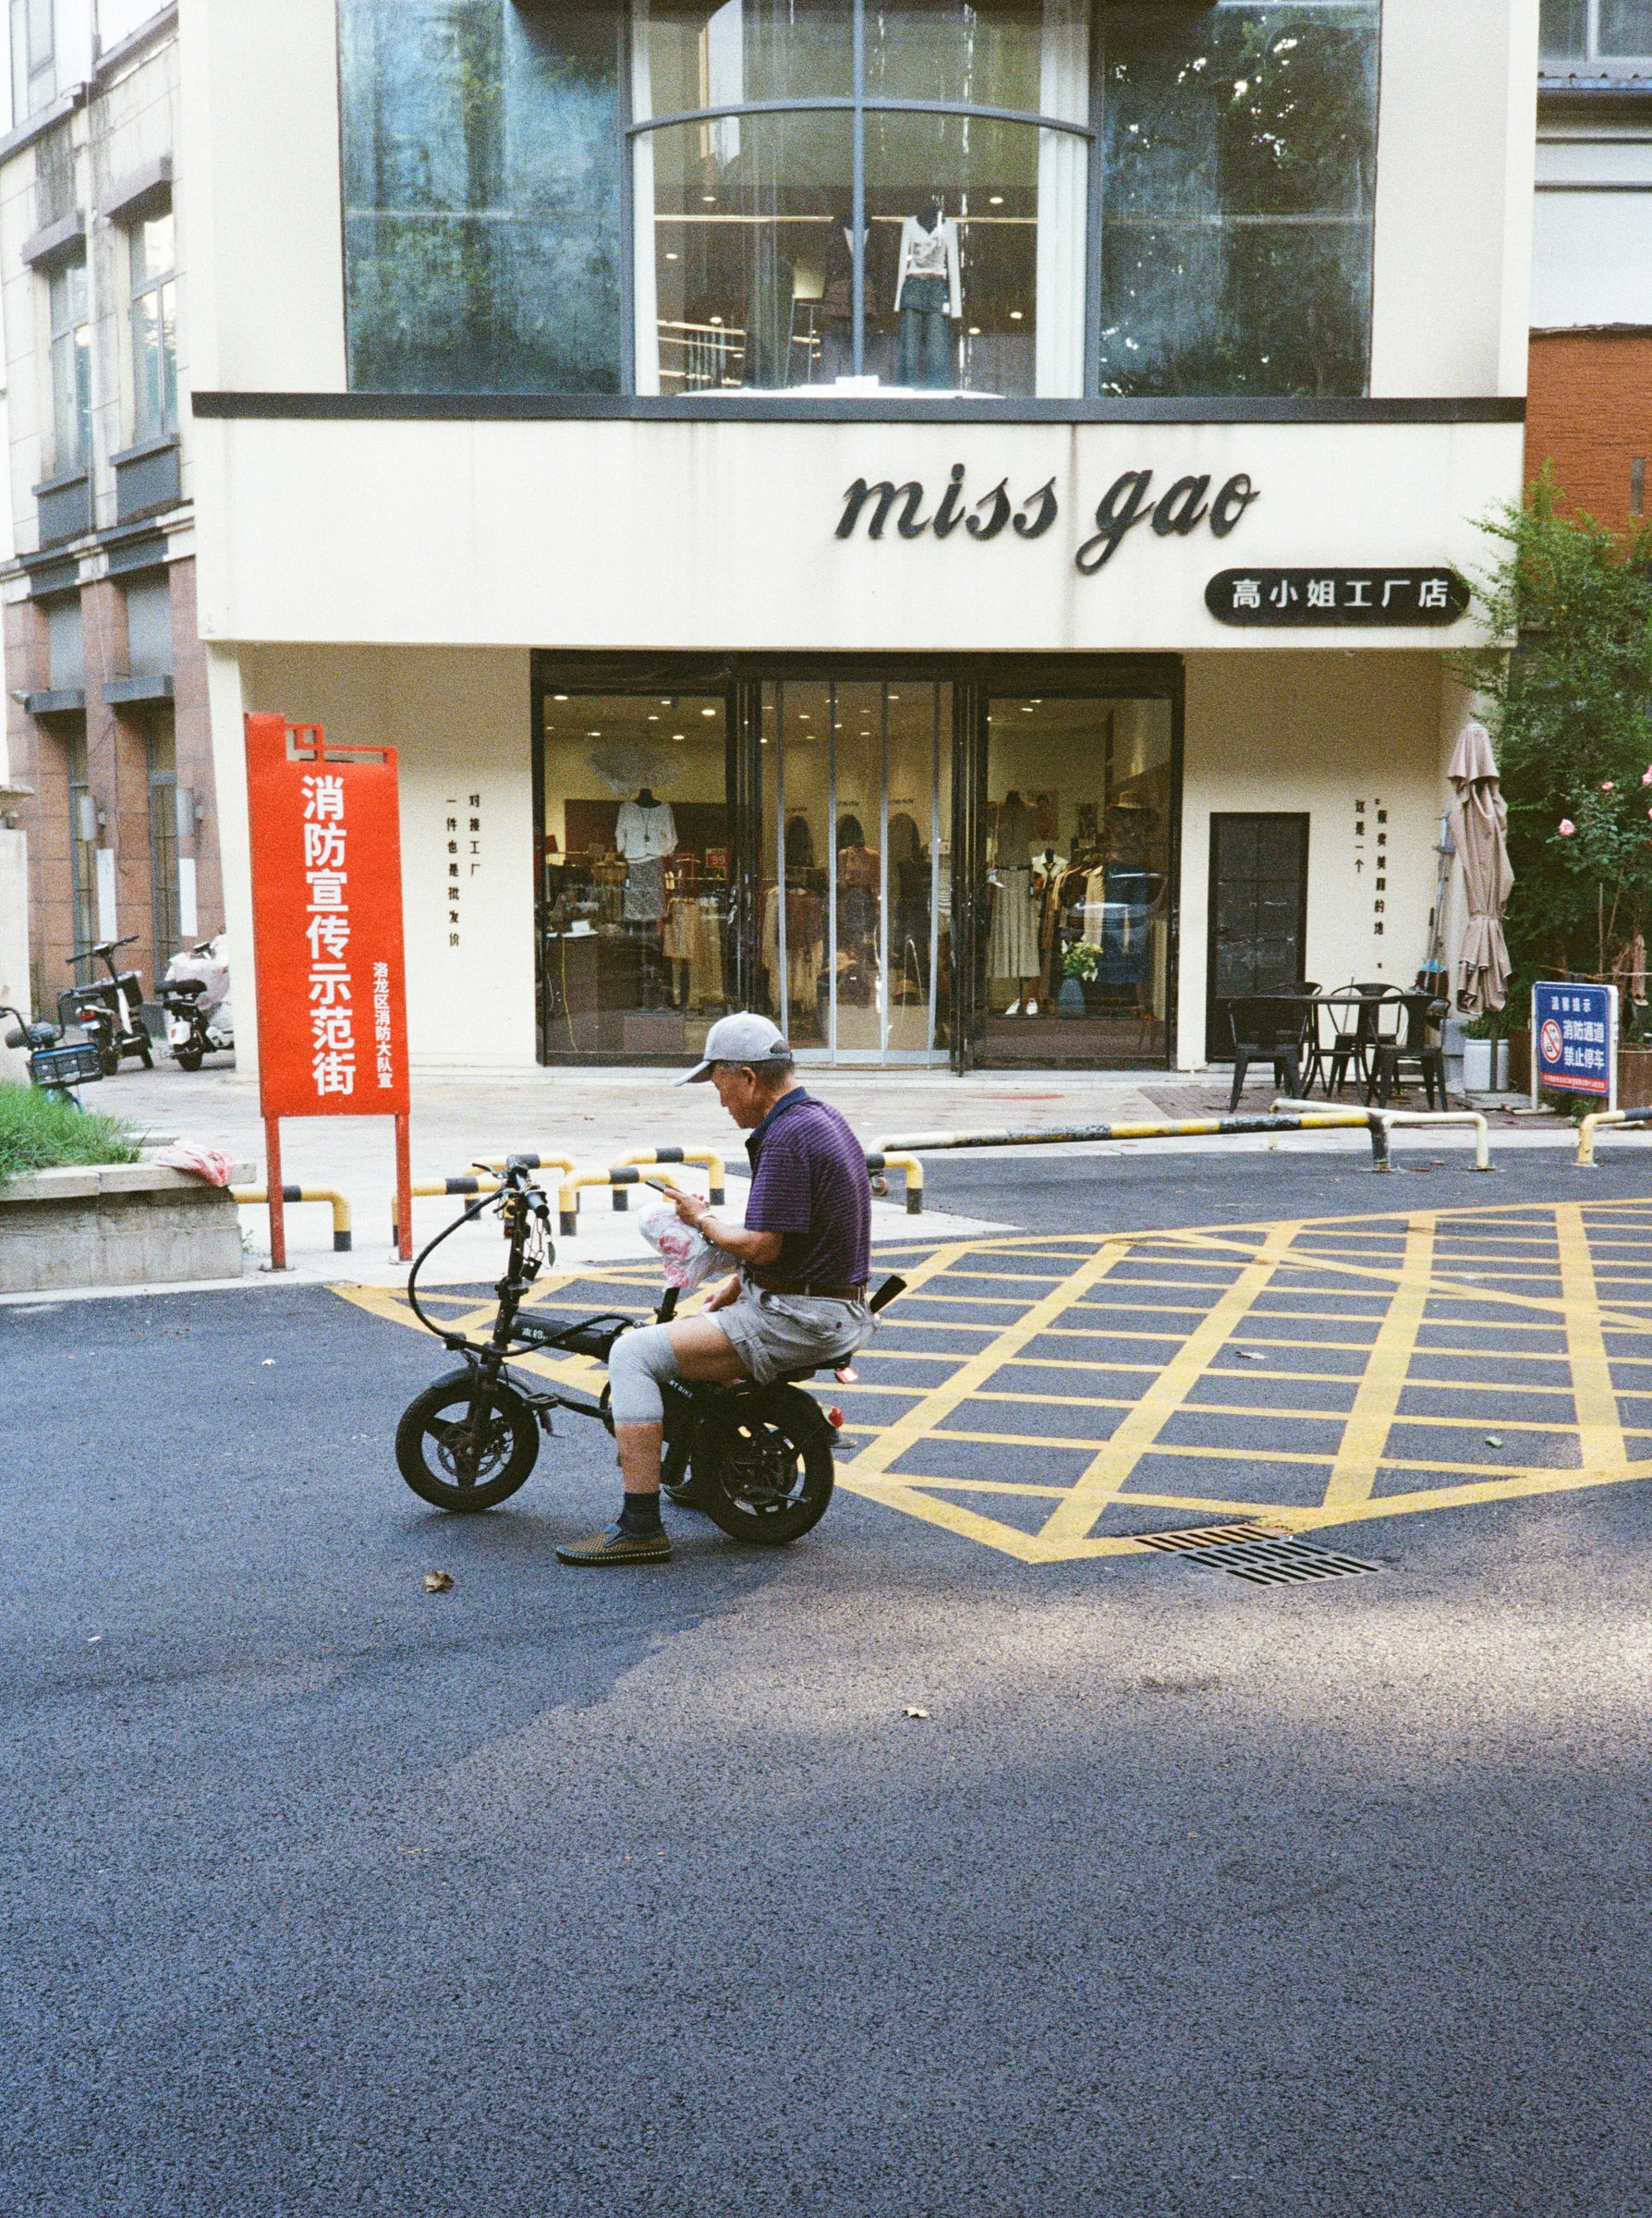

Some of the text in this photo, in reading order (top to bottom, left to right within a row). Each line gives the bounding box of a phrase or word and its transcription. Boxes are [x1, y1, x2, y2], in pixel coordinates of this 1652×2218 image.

[835, 462, 1260, 576] miss gao
[1232, 579, 1449, 609] 高小姐工厂店
[445, 798, 460, 947] 一件也是批发价
[468, 794, 481, 877] 对接工厂
[1354, 798, 1366, 873] 这是一个
[300, 774, 357, 1096] 消防宣传示范街
[372, 961, 394, 1089] 洛龙区消防大队宣
[1561, 1018, 1605, 1043] 消防通道
[1563, 1046, 1605, 1070] 禁止停车
